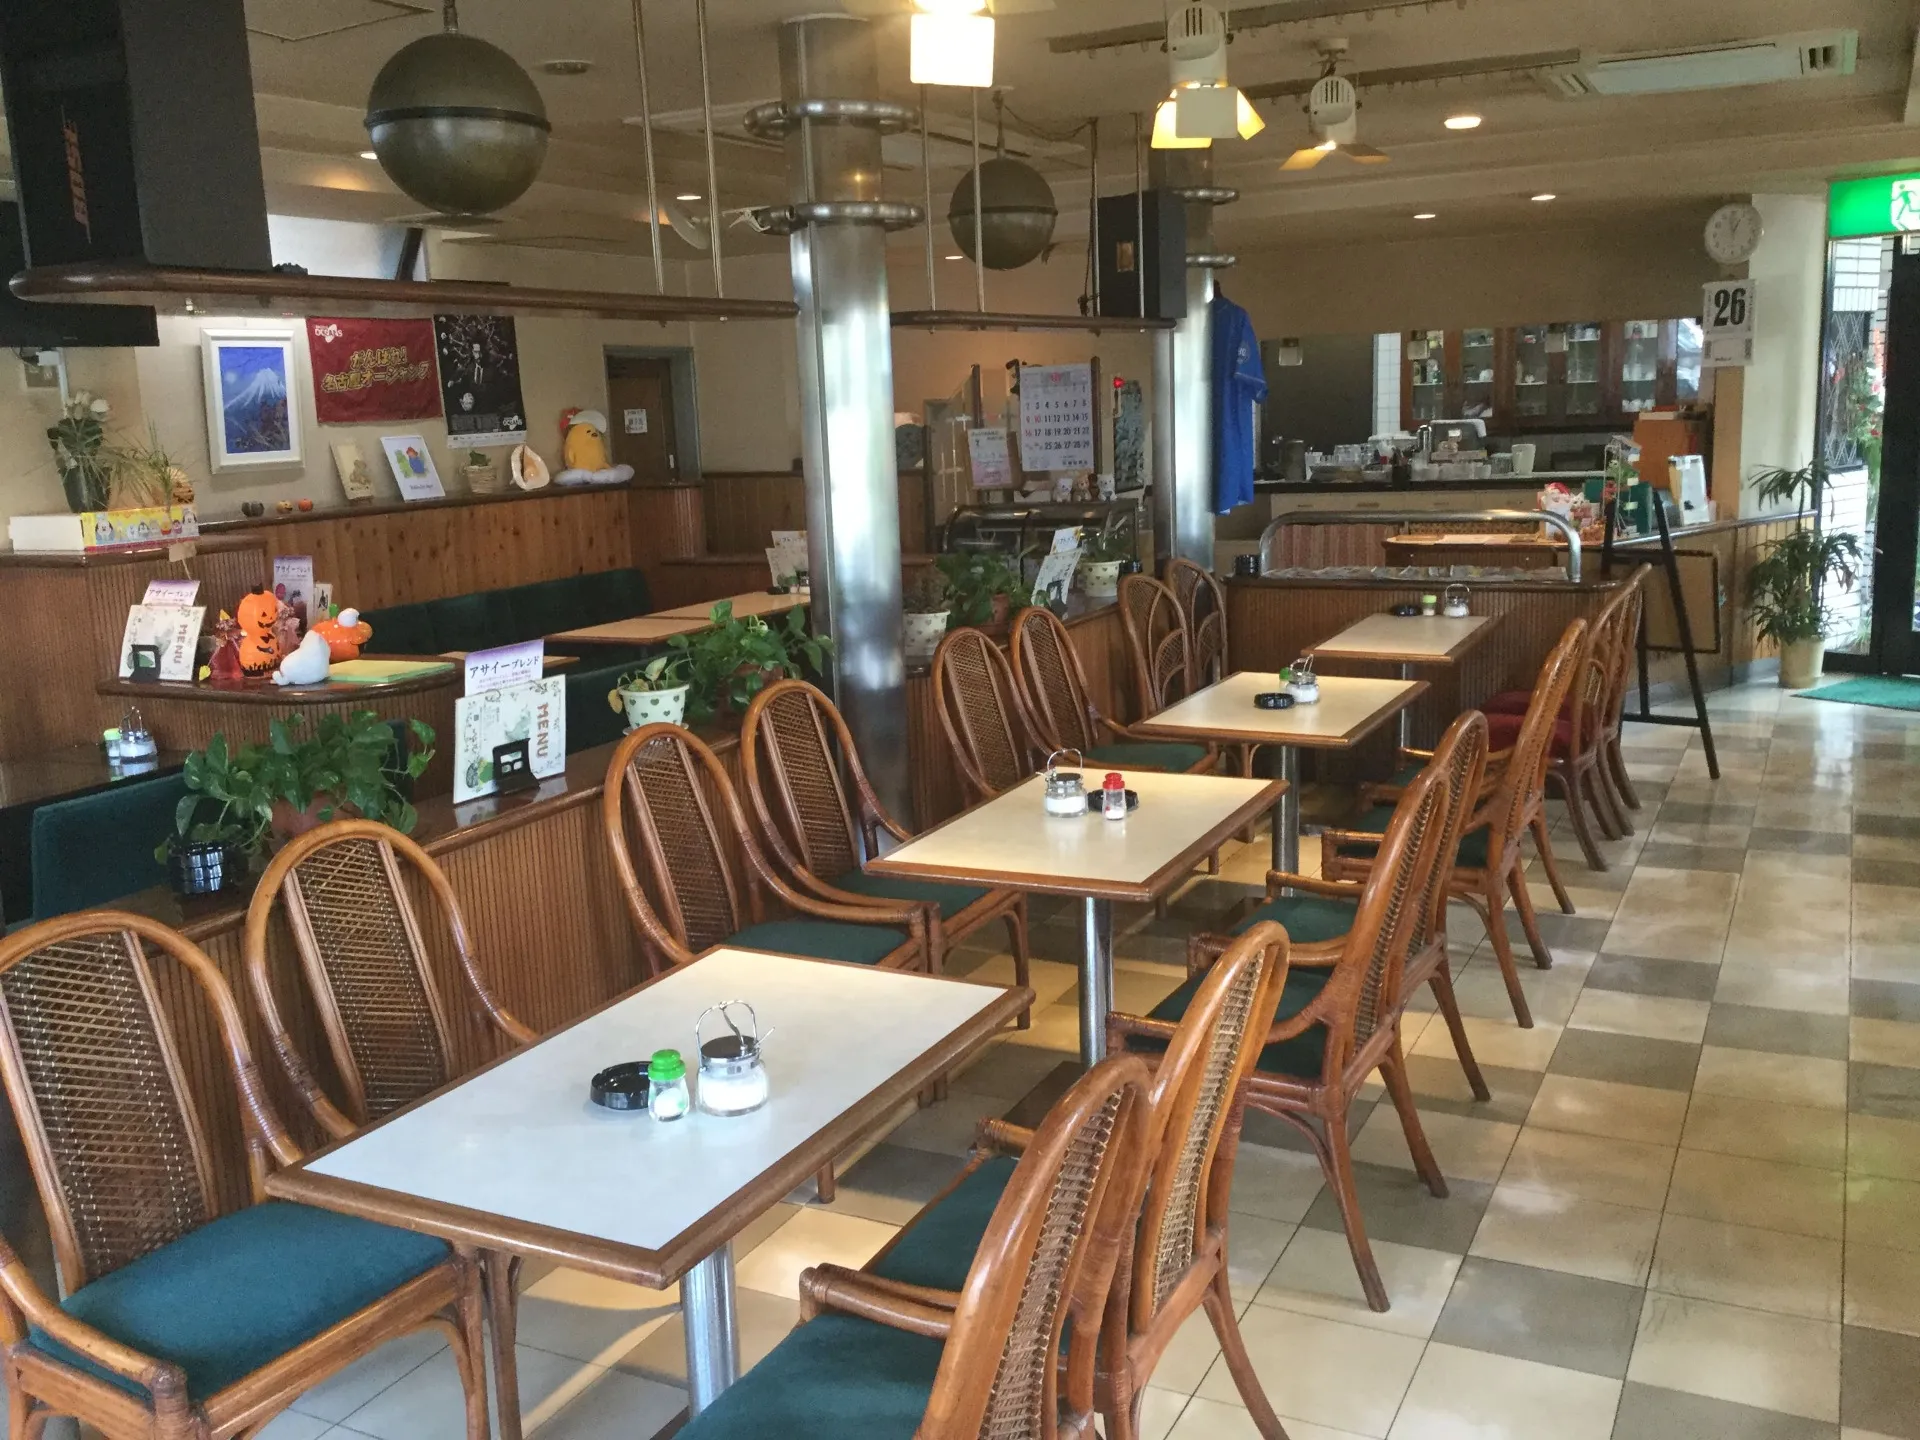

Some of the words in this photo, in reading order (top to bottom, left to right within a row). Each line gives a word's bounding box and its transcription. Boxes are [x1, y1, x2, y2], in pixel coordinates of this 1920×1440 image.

[1713, 288, 1746, 327] 26
[173, 623, 188, 664] MENU
[469, 655, 540, 679] アサイーブレンド
[536, 702, 550, 758] MENU
